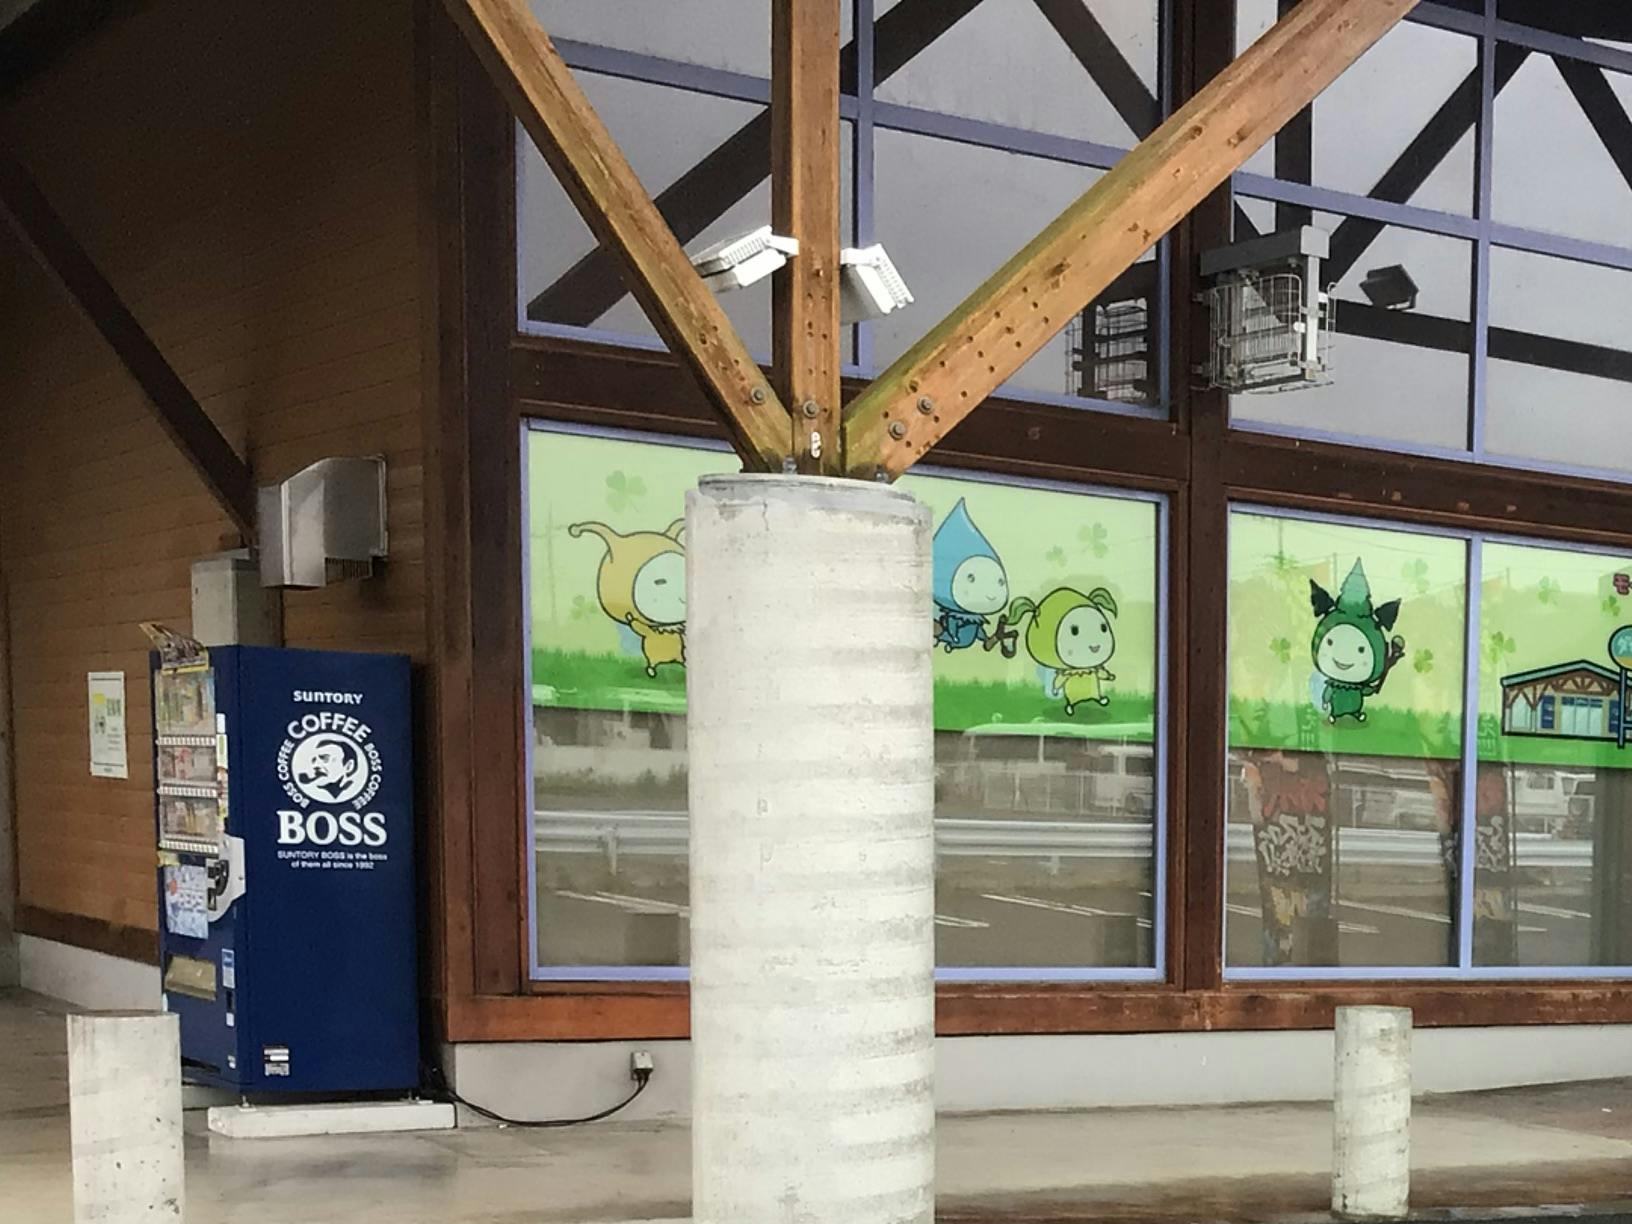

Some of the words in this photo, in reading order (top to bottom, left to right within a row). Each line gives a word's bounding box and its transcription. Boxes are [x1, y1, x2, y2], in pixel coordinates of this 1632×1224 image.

[293, 690, 363, 704] SUNTORY
[287, 712, 372, 743] COFFEE
[276, 811, 388, 846] BOSS
